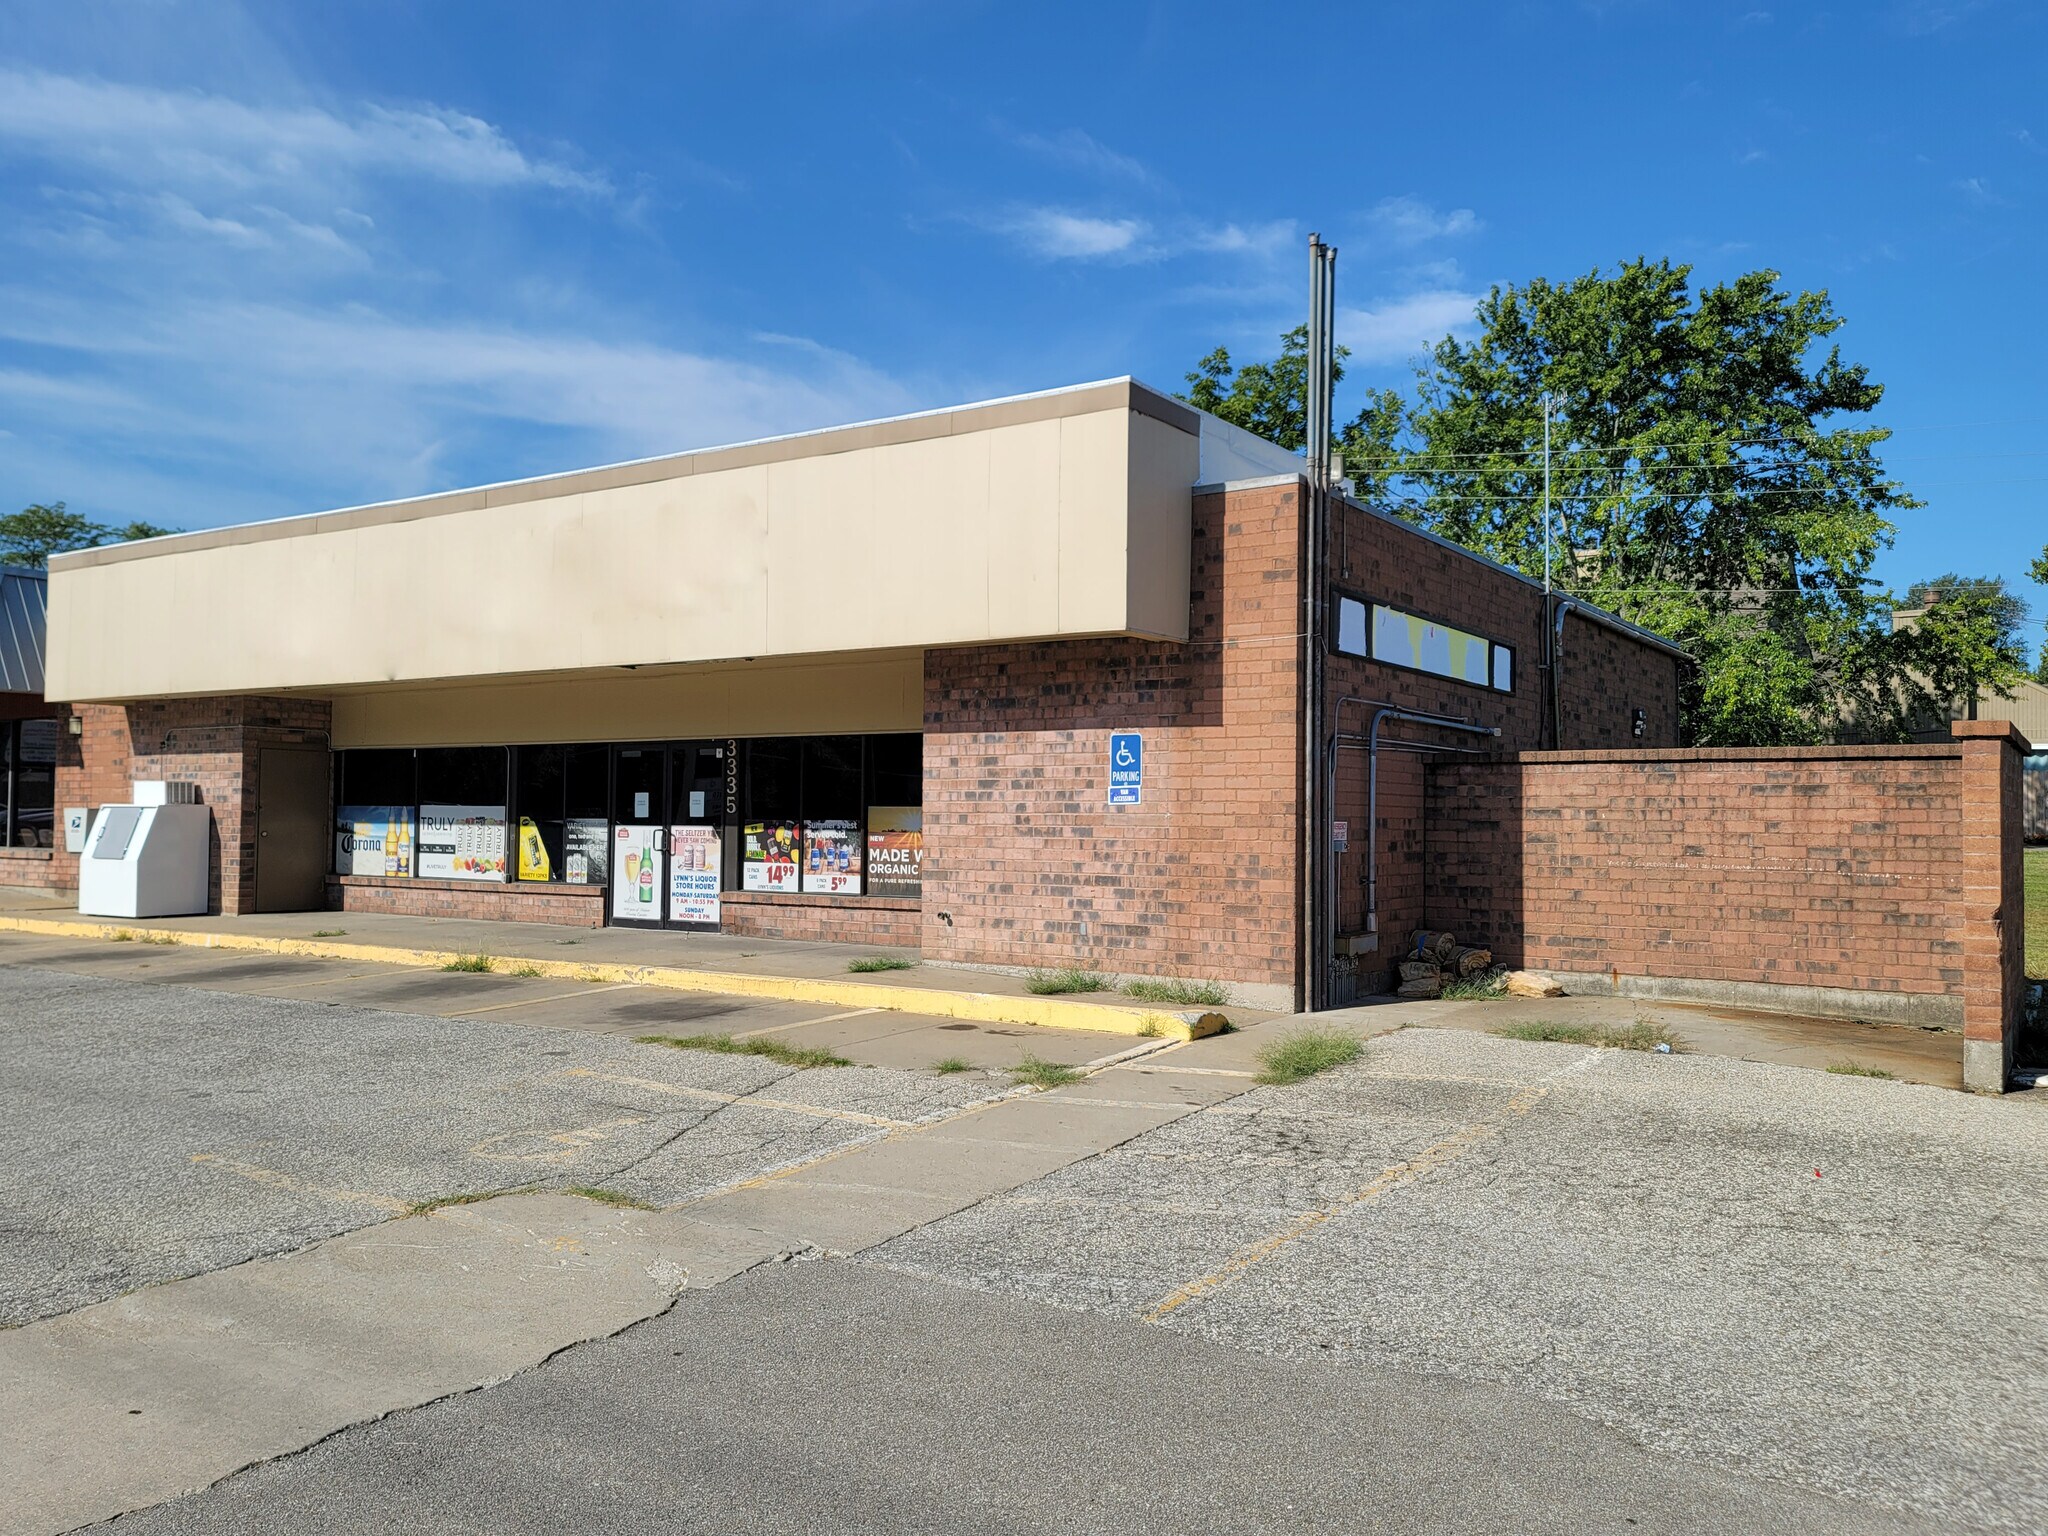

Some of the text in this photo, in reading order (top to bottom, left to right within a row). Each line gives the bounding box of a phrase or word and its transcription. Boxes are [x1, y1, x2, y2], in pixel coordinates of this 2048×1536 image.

[726, 739, 737, 813] 3335
[1112, 771, 1140, 782] PARKING
[420, 816, 455, 831] TRULY
[842, 820, 857, 829] best
[341, 834, 381, 857] Corona
[869, 848, 910, 862] MADE
[869, 863, 919, 875] ORGANIC
[695, 875, 717, 883] LIQUOR
